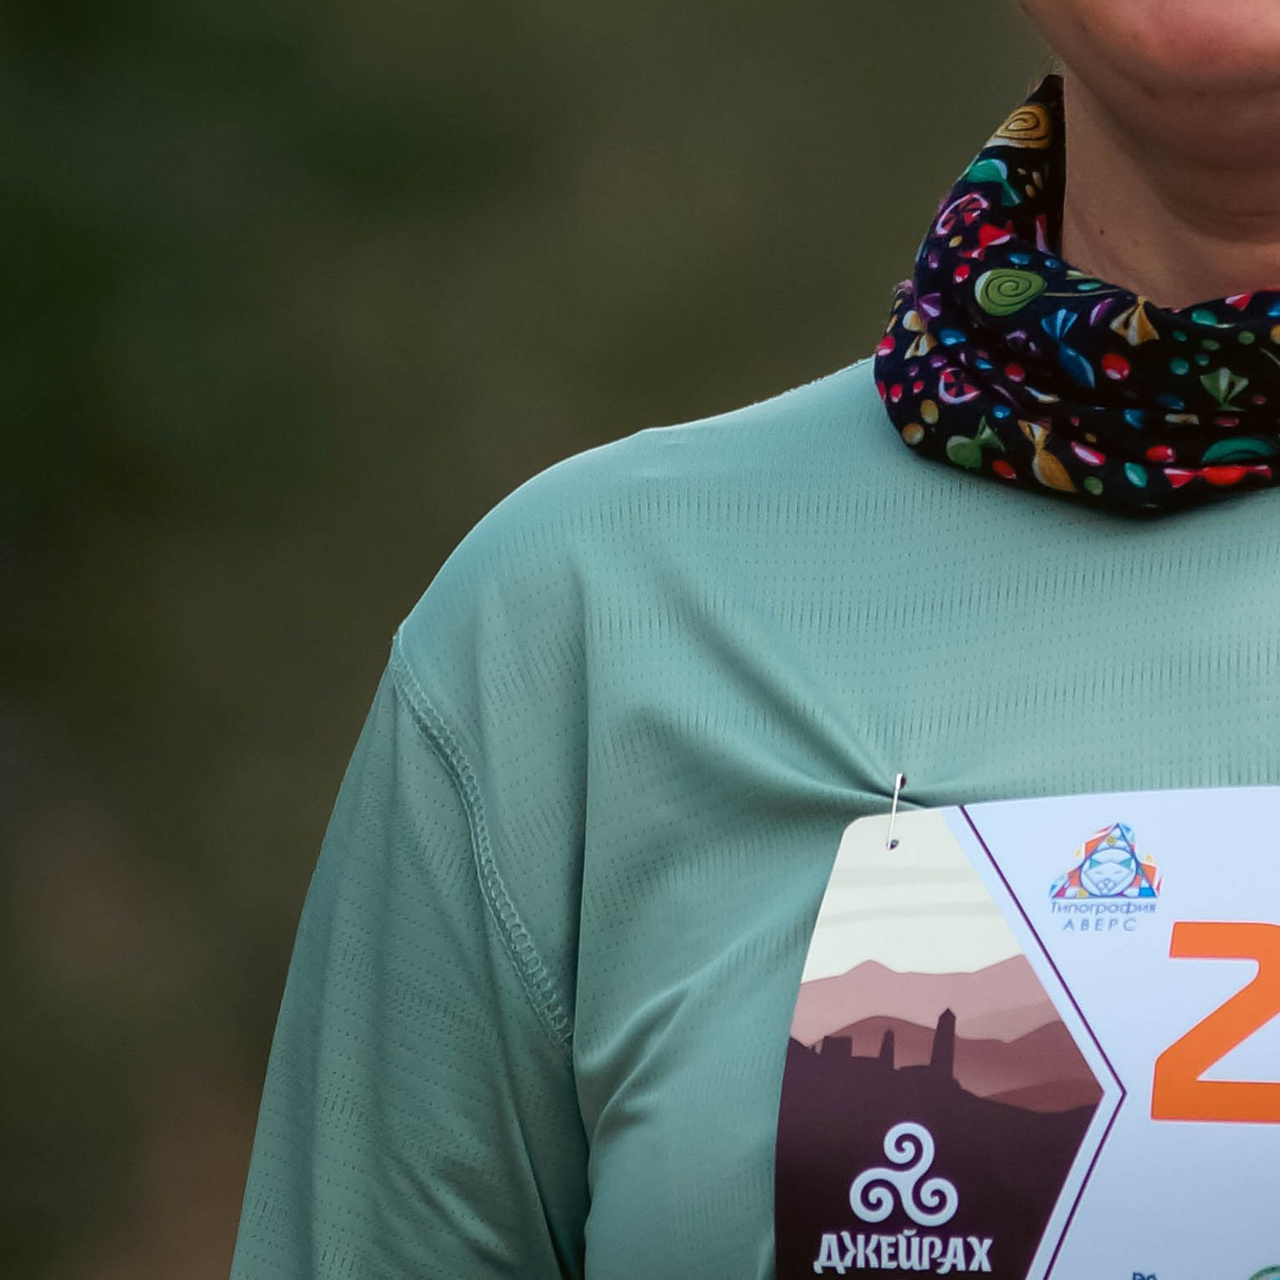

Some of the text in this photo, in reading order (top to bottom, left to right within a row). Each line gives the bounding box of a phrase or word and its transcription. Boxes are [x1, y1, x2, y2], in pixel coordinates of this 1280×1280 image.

[1051, 901, 1157, 917] Типография
[1063, 919, 1137, 931] АВЕРС
[813, 1229, 994, 1275] ДЖЕЙРАХ
